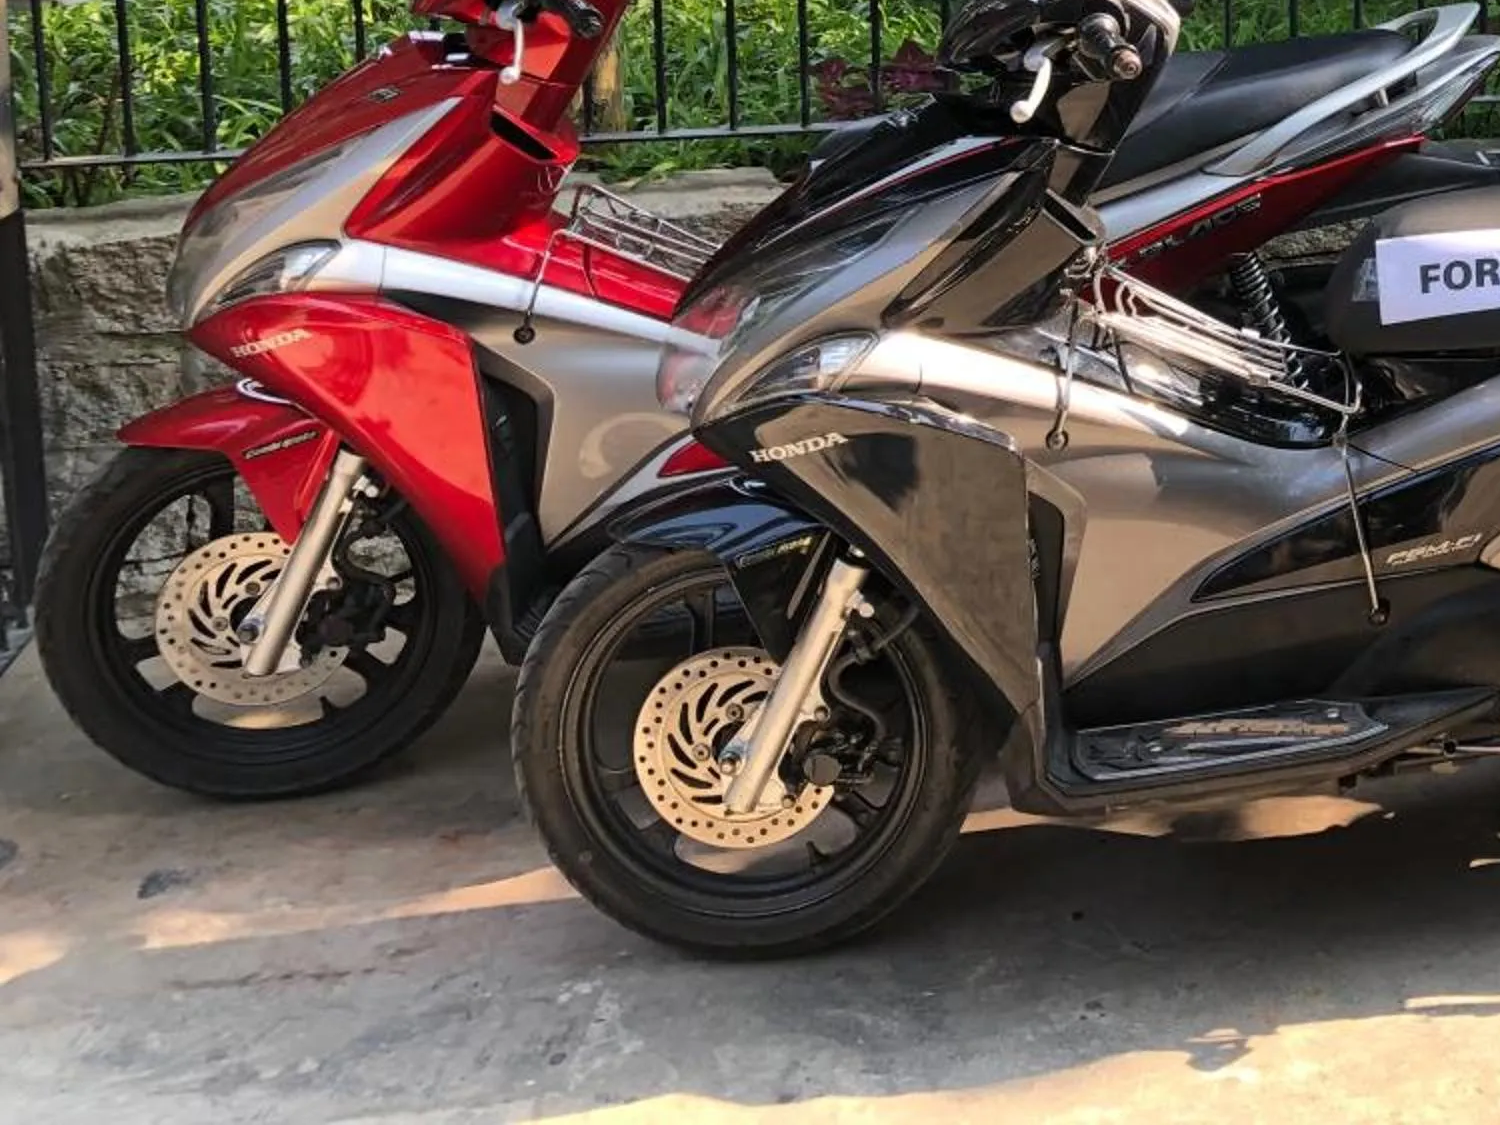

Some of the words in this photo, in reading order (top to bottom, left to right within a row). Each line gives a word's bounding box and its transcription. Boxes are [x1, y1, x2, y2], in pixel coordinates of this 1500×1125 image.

[1419, 258, 1500, 294] FOR
[229, 328, 314, 359] HONDA
[748, 431, 849, 463] HONDA
